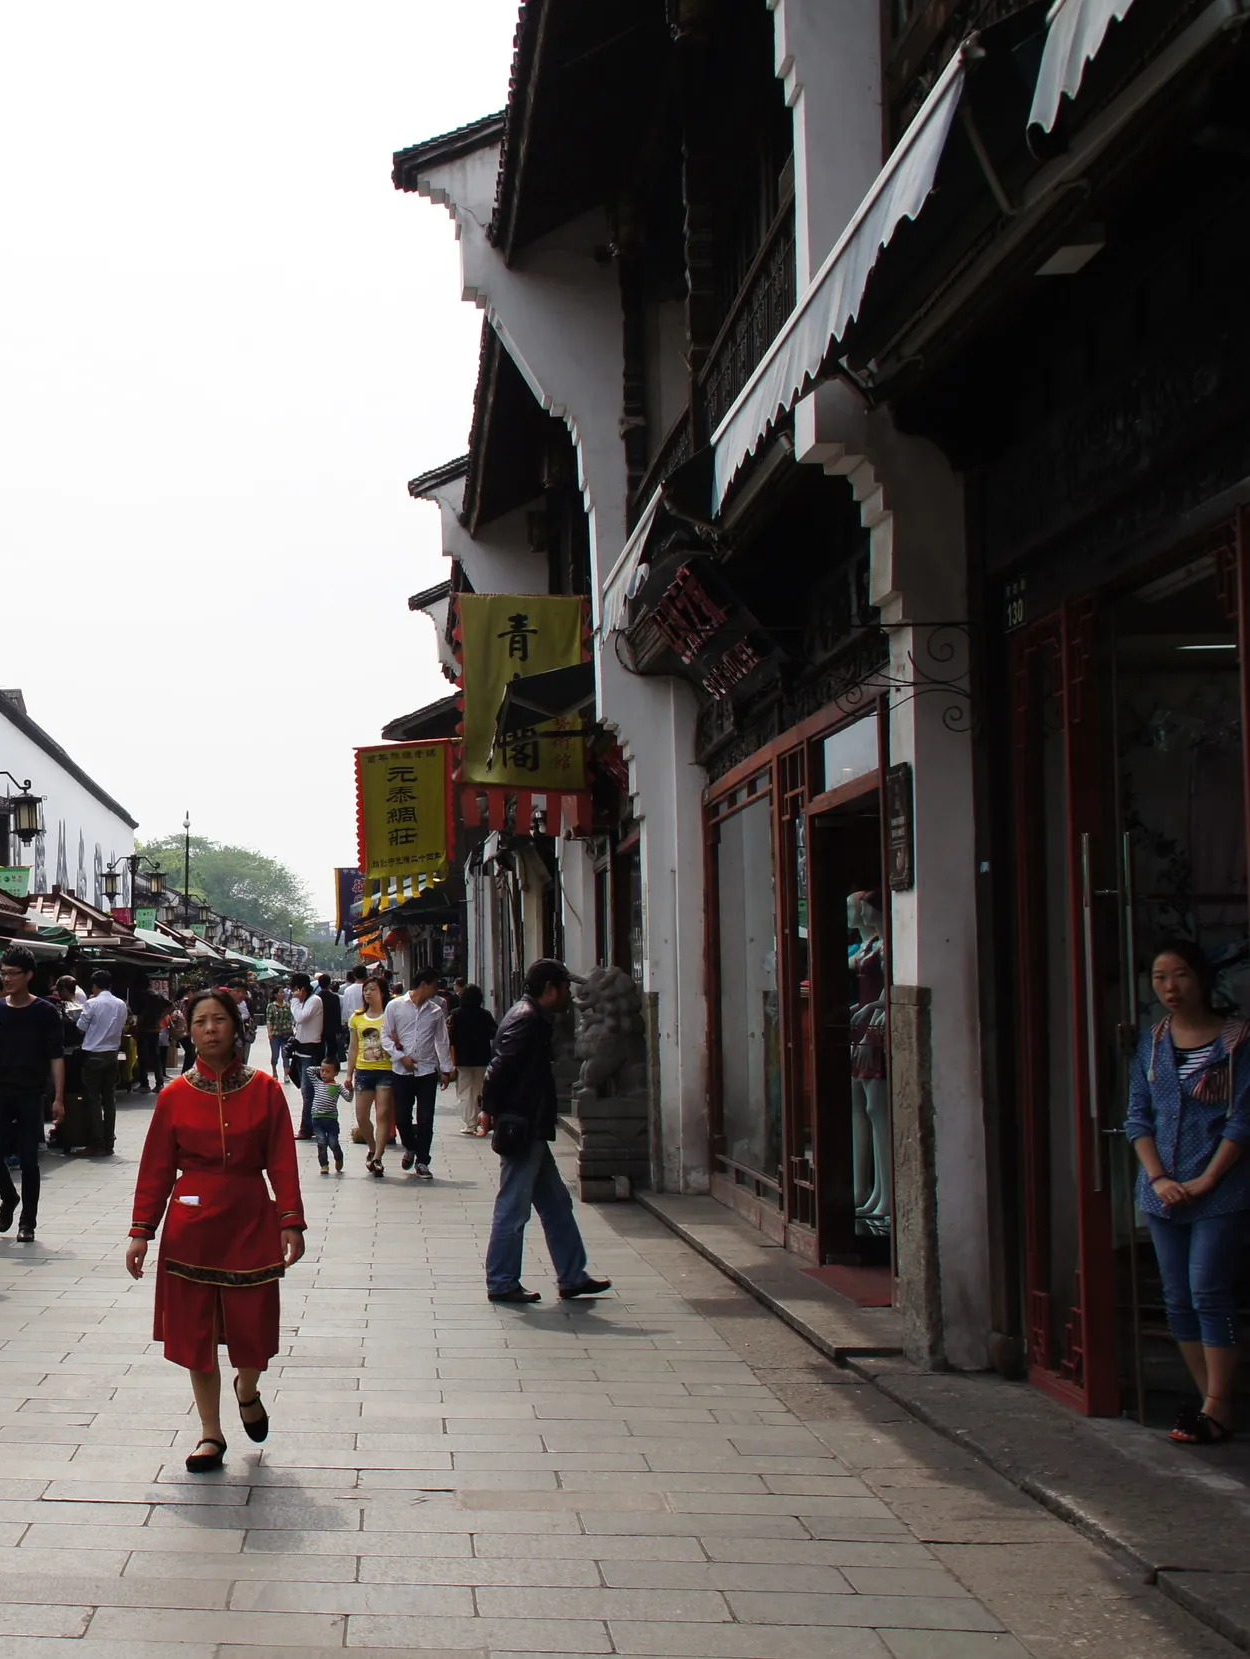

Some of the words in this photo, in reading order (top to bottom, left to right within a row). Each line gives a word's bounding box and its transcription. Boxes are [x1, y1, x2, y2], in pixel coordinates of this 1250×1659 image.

[1007, 598, 1024, 627] 130
[386, 766, 418, 846] 元泰綢莊
